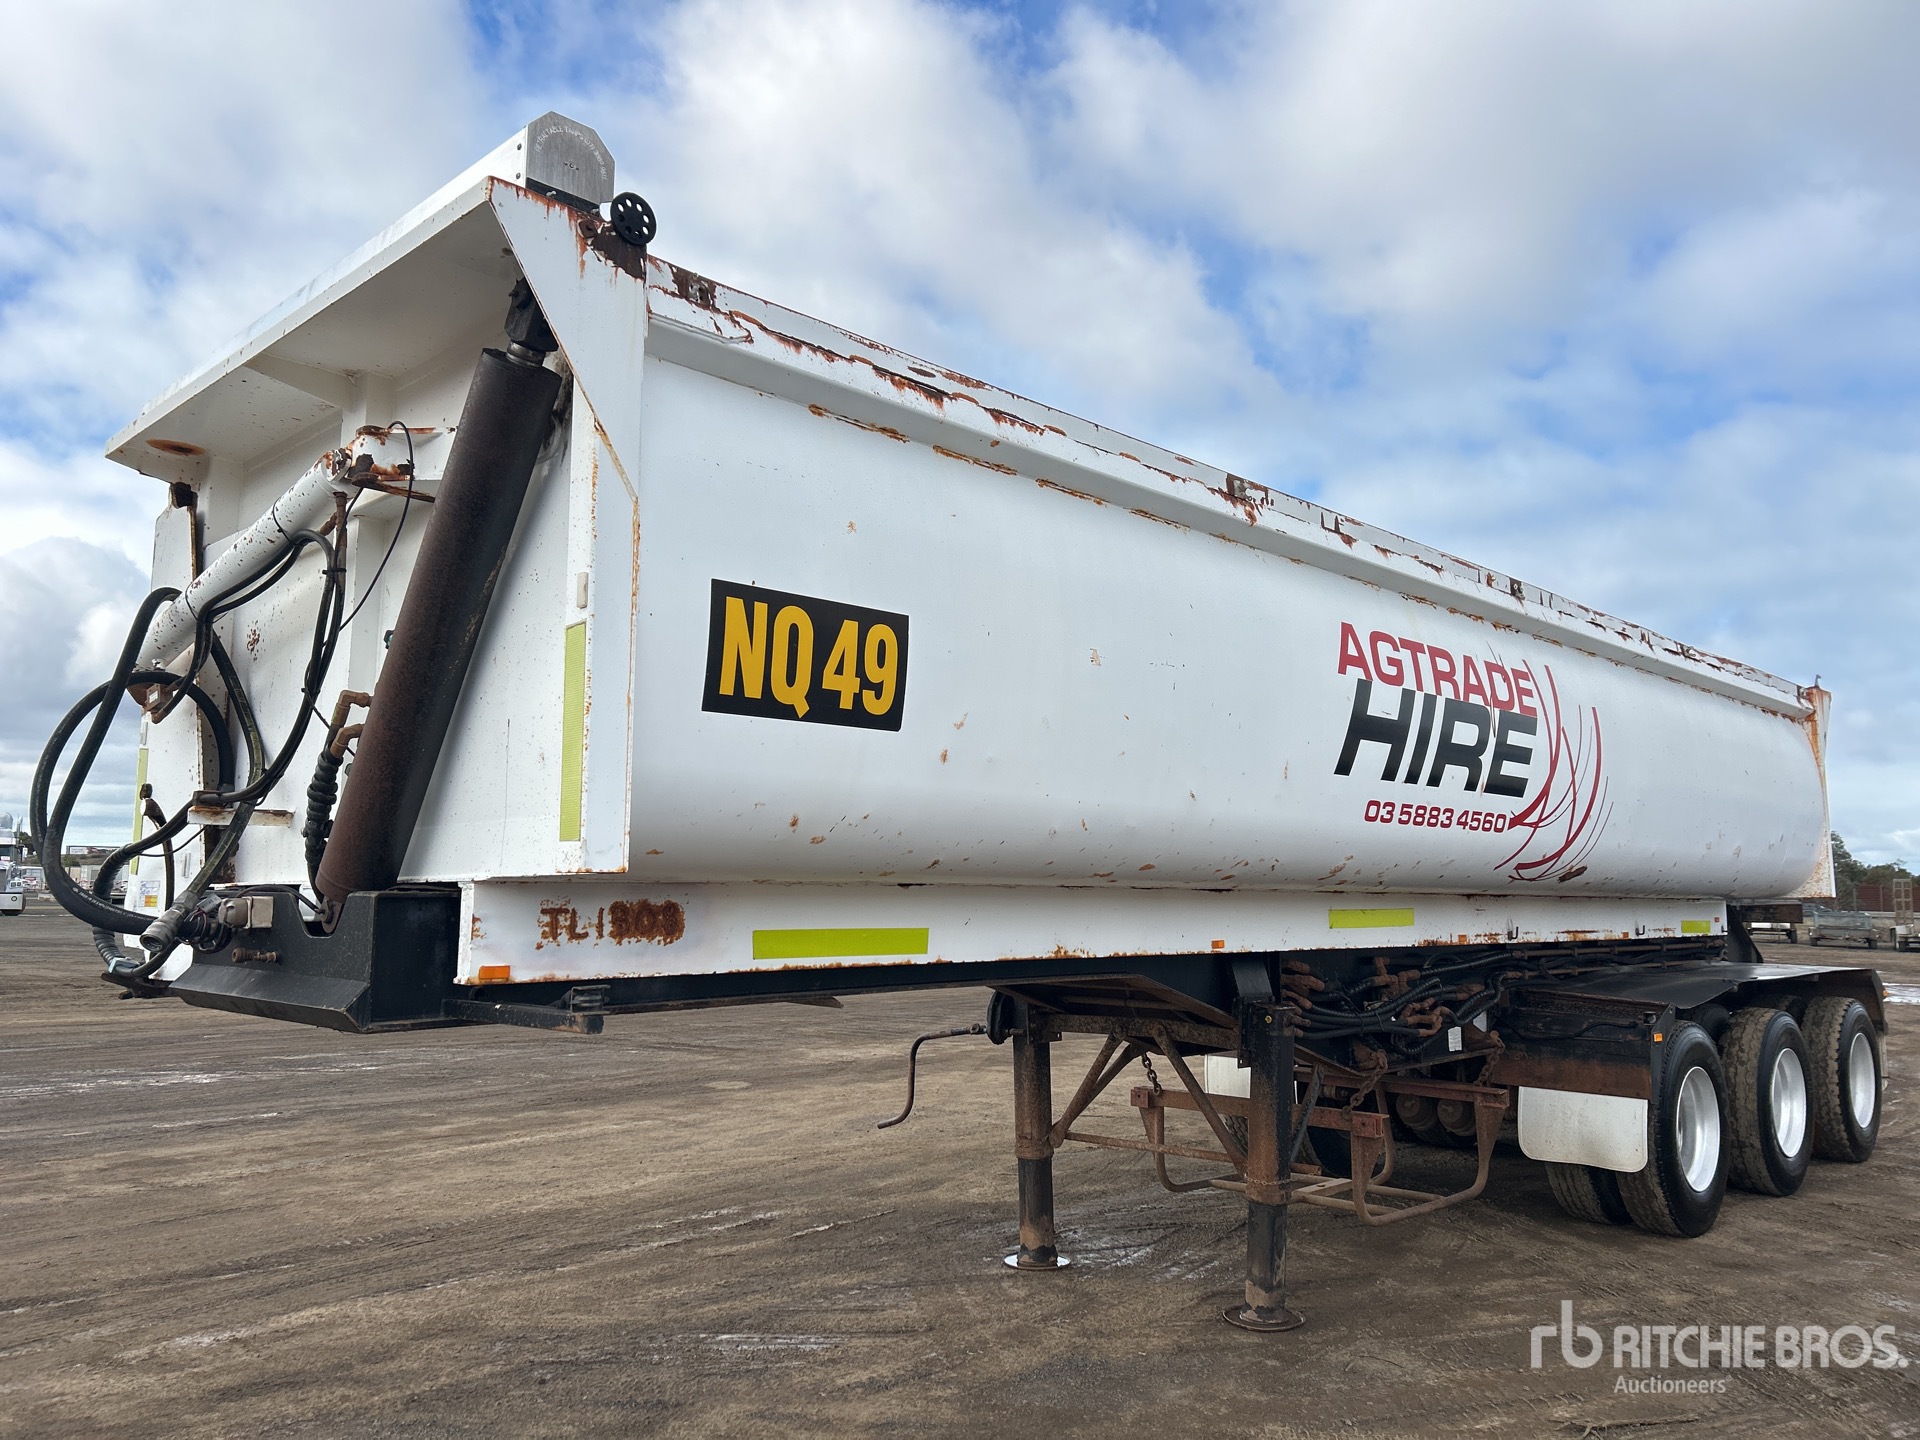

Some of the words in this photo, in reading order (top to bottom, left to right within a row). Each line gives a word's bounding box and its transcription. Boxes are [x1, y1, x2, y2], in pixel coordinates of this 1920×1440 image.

[719, 596, 814, 718] NQ
[822, 619, 899, 715] 49
[1337, 621, 1538, 718] AGTRADE
[1333, 678, 1538, 799] HIRE
[1364, 800, 1395, 823] 03
[1398, 803, 1454, 828] 5883
[1456, 810, 1507, 833] 4560
